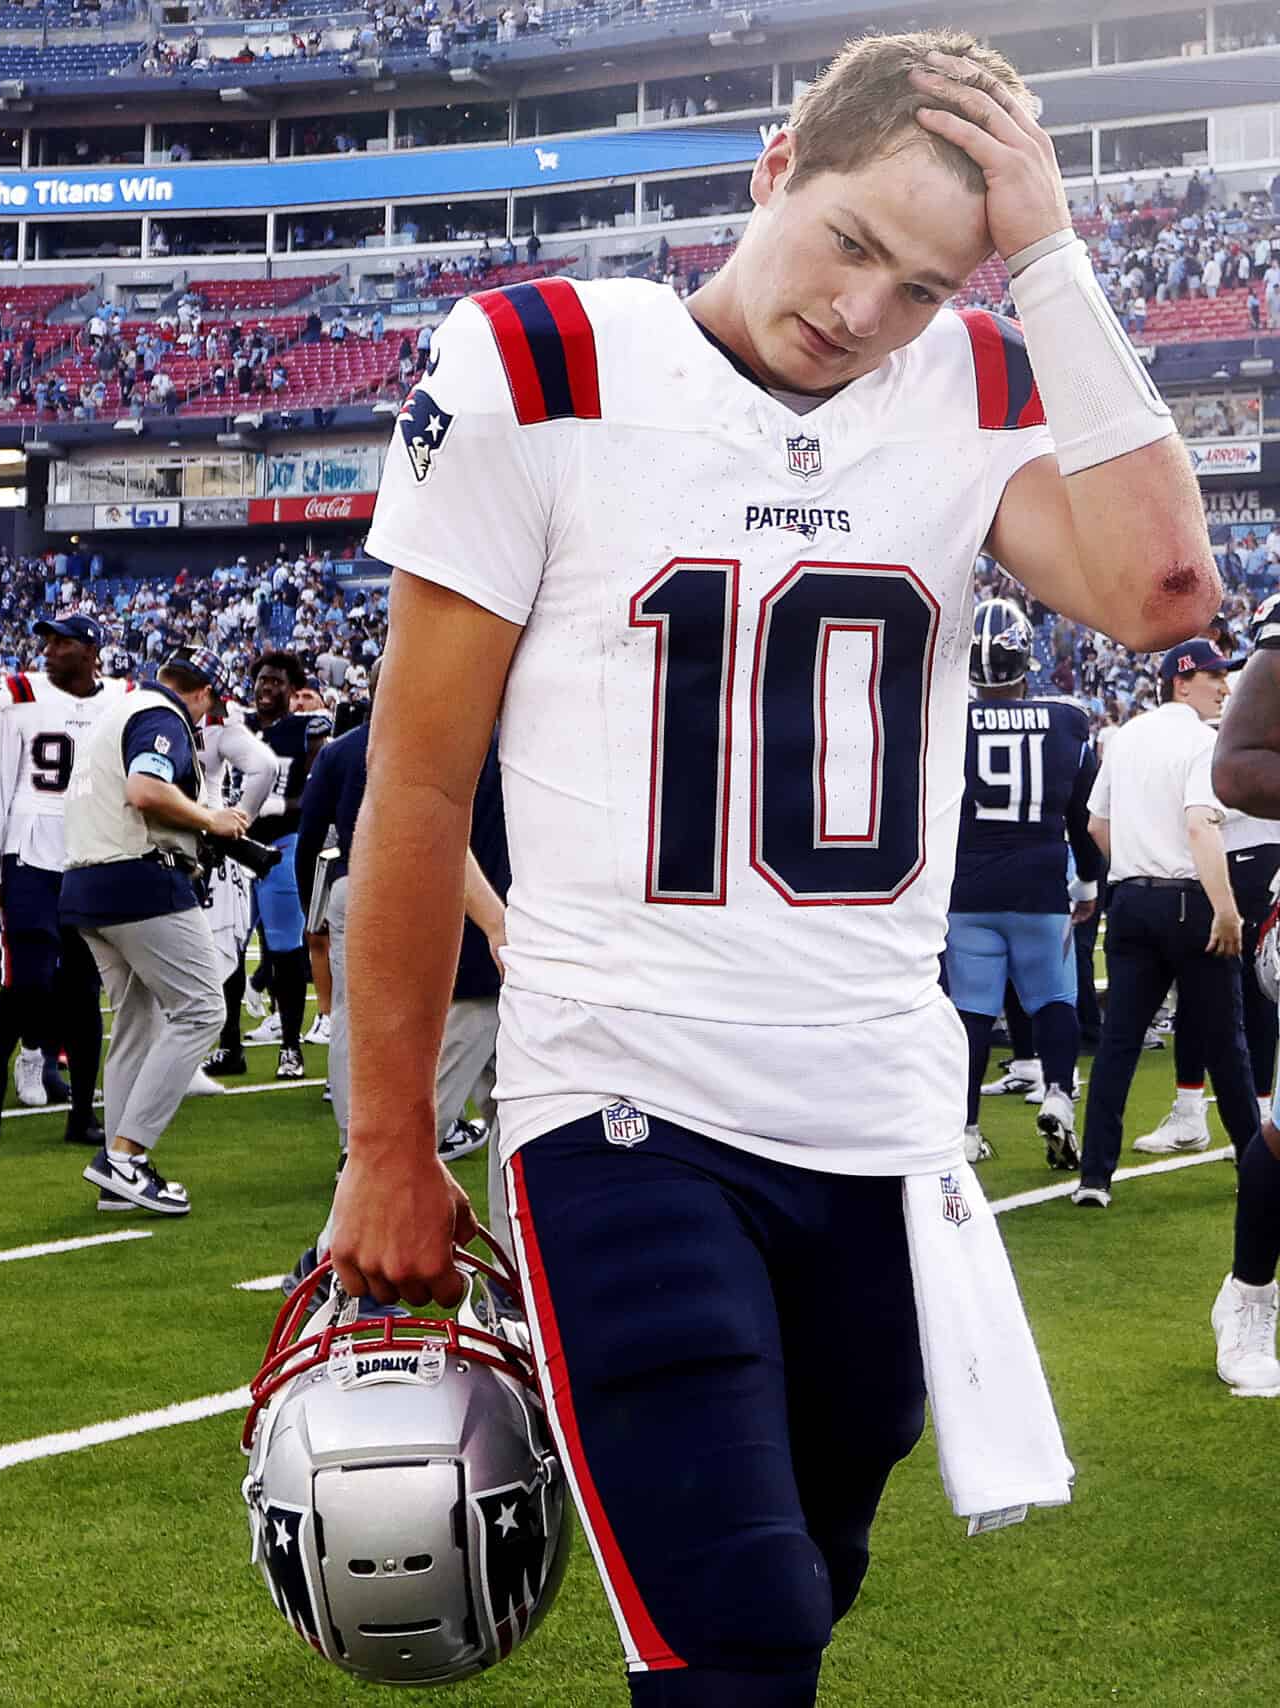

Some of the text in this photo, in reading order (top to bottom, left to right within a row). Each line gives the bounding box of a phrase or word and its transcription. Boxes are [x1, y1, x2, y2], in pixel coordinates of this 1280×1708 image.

[33, 178, 114, 205] Titans
[119, 176, 172, 202] Win
[791, 451, 819, 470] NFL
[745, 506, 851, 533] PATRIOTS
[971, 708, 1050, 730] COBURN
[628, 557, 942, 907] 10
[31, 732, 75, 795] 9
[975, 734, 1046, 822] 91
[612, 1120, 642, 1138] NFL
[945, 1196, 969, 1220] NFL
[356, 1356, 419, 1379] PATRIOTS
